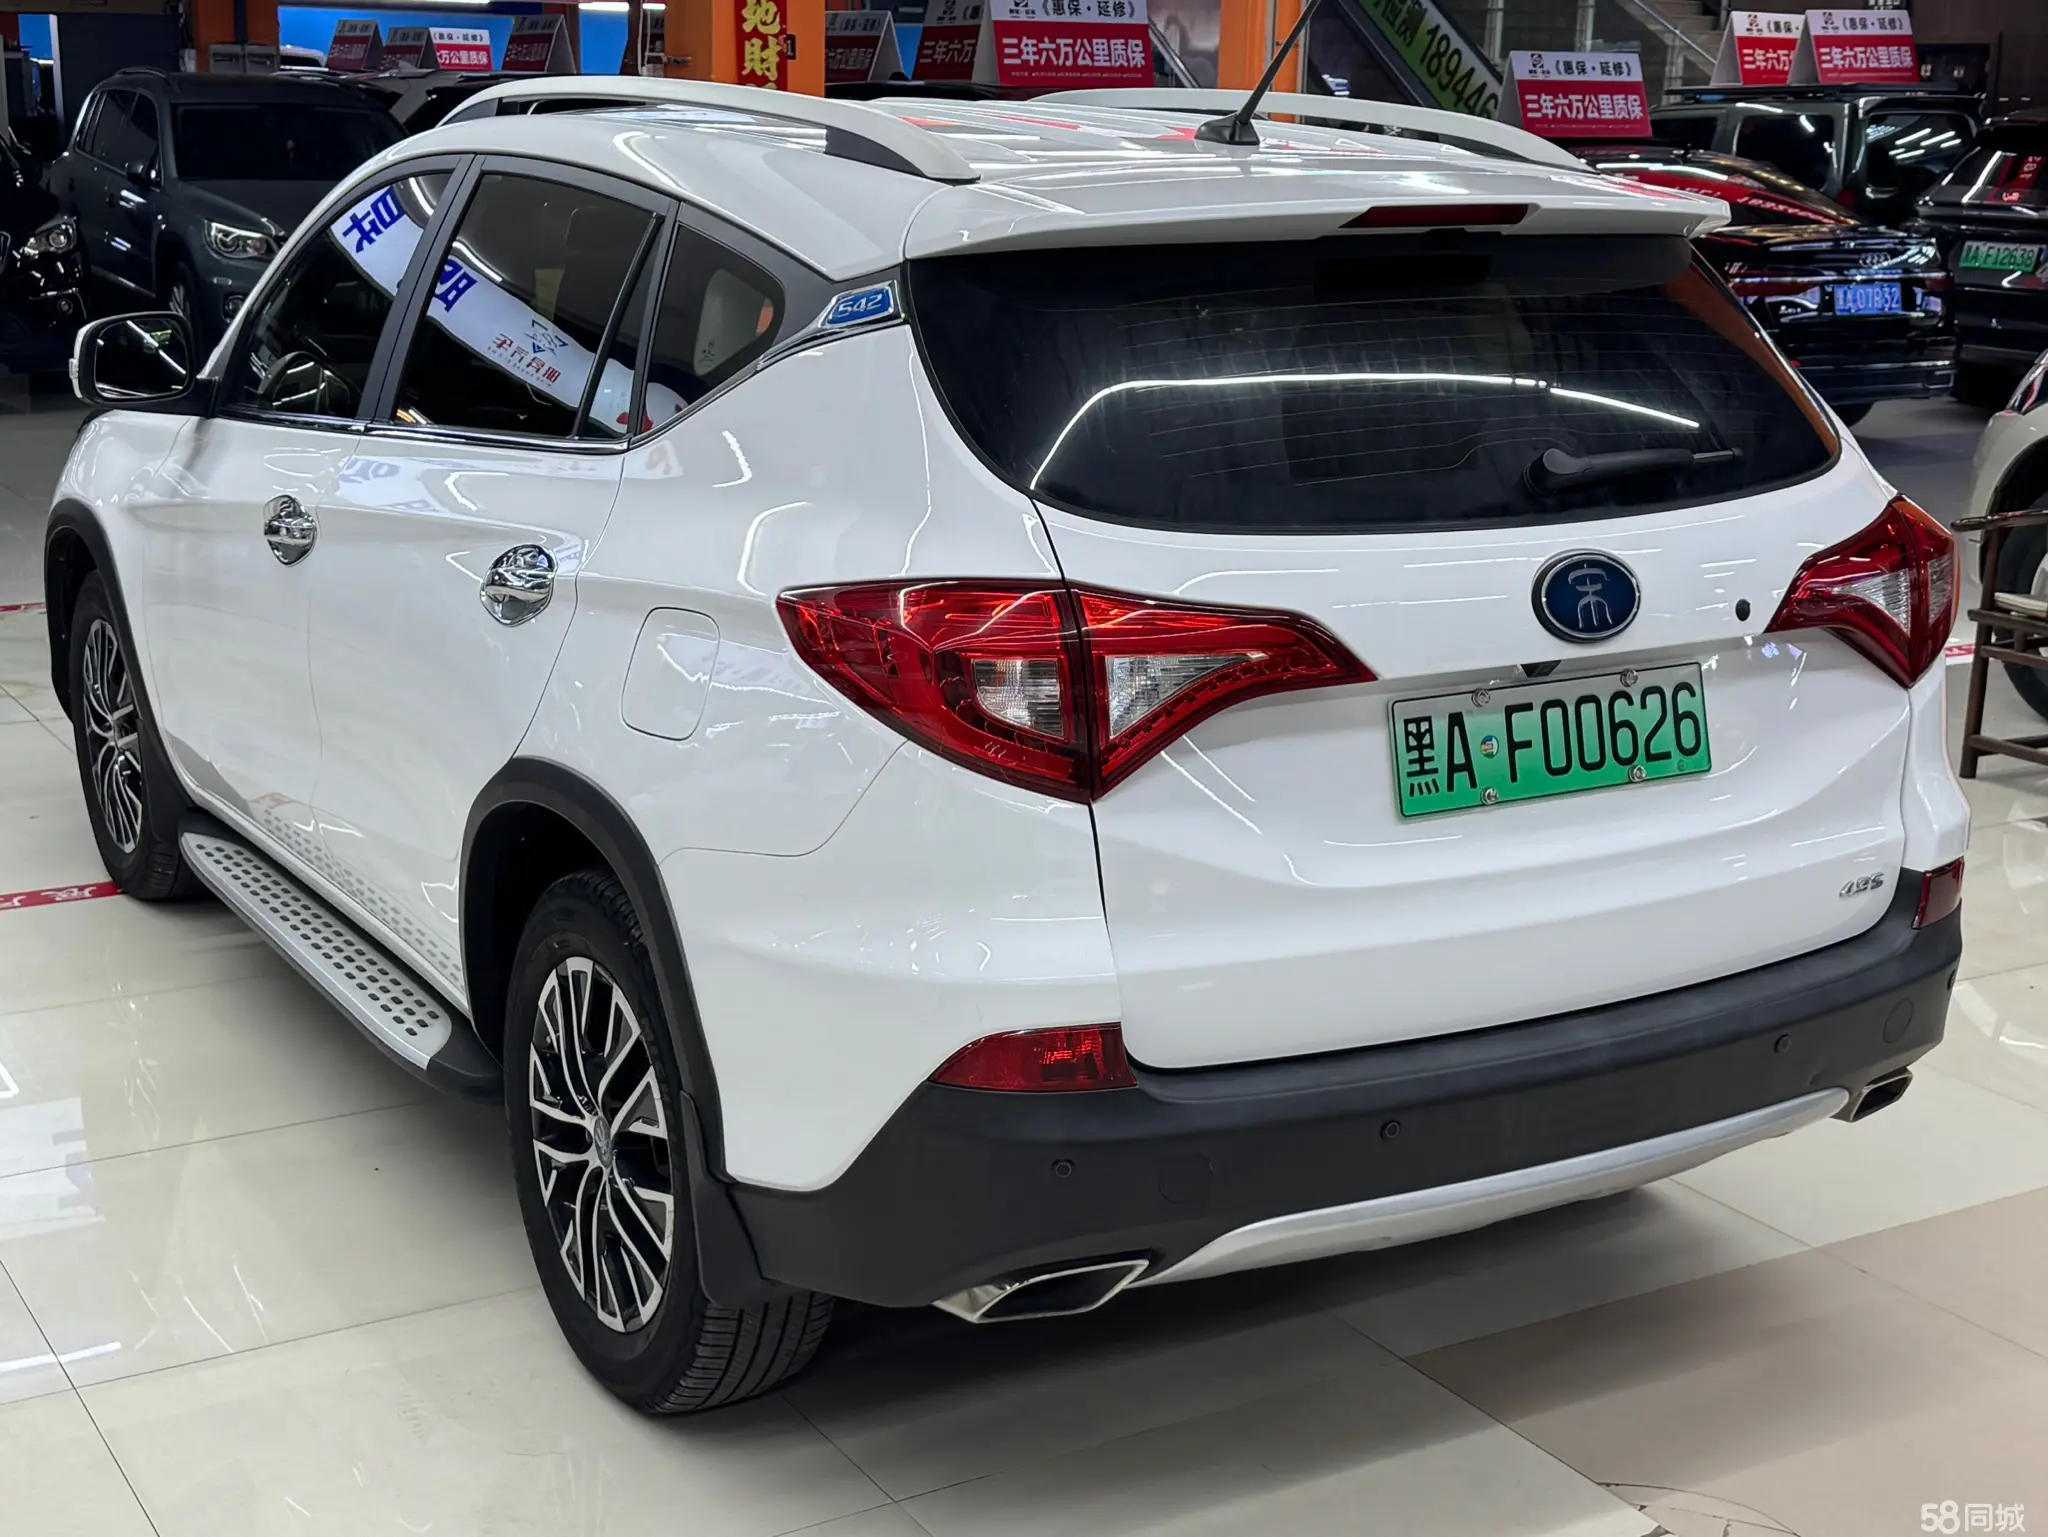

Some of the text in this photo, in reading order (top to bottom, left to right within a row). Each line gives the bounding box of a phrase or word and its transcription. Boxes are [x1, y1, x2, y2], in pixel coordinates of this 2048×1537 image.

[1002, 36, 1146, 68] 三年六万公里质保
[1819, 46, 1914, 68] 三年六万公里质保
[1524, 93, 1644, 119] 三年六万公里质保
[838, 293, 883, 317] 542
